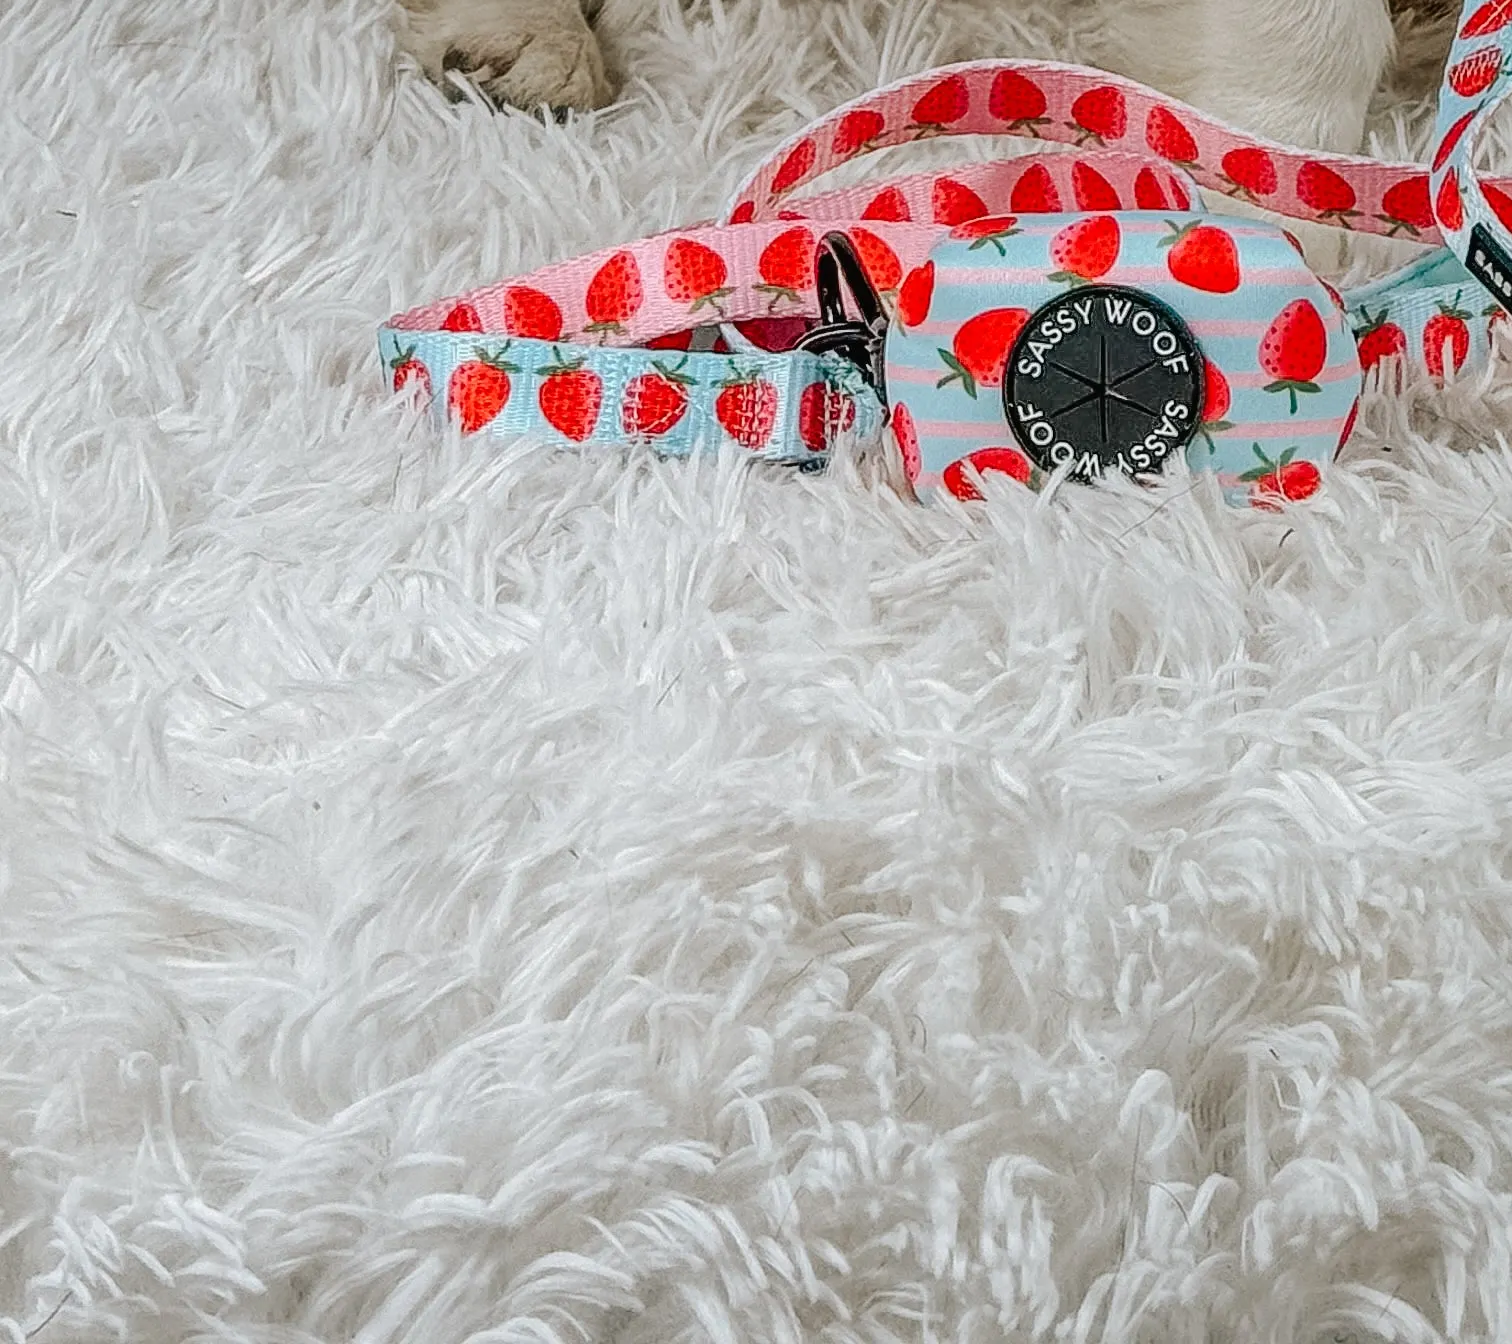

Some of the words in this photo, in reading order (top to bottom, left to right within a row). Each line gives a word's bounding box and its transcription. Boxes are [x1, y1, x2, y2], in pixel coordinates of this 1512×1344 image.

[1018, 300, 1092, 379] SASSY
[1105, 297, 1188, 374] WOOF
[1016, 403, 1100, 477] WOOF
[1118, 400, 1188, 474] SASSY
